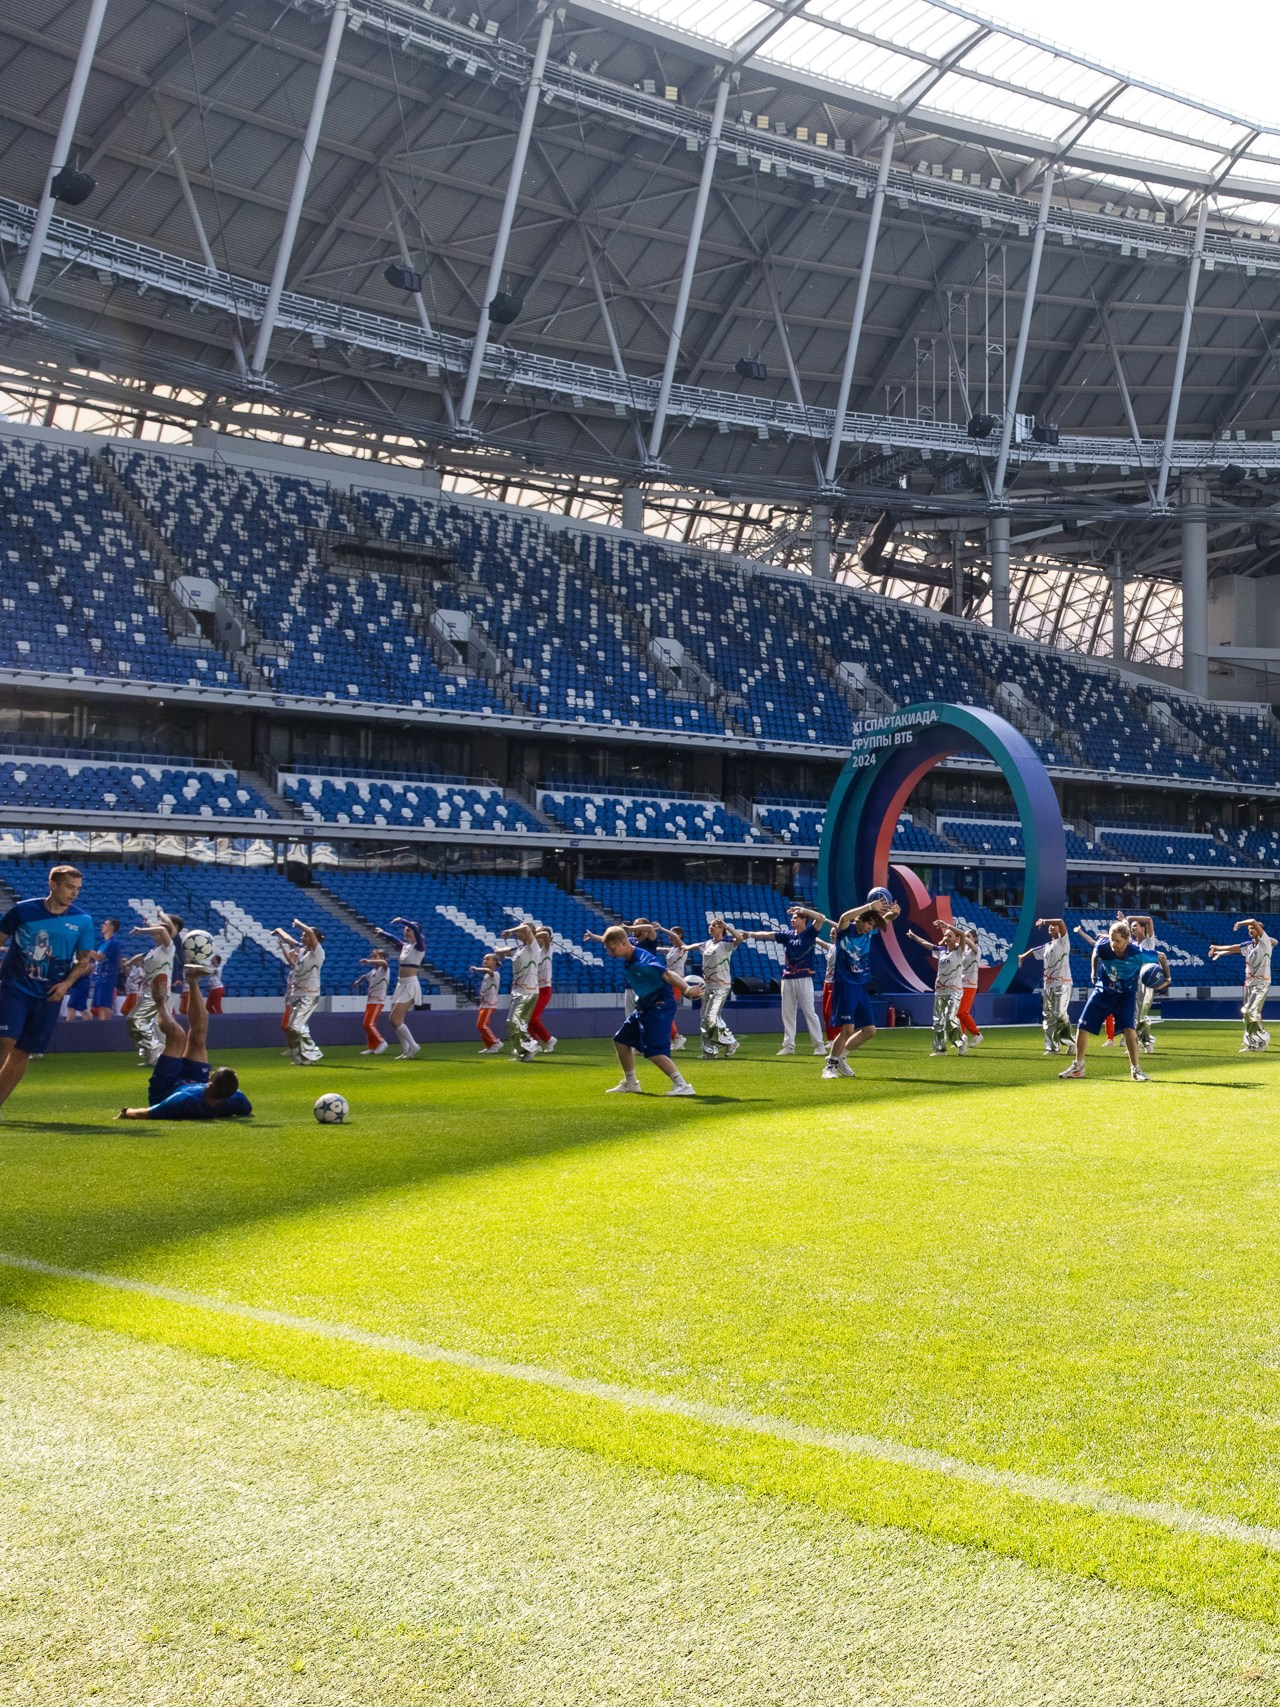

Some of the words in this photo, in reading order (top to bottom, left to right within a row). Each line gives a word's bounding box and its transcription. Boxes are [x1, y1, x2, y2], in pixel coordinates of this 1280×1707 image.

[864, 709, 939, 731] СПАРТАКИАДА
[852, 735, 892, 750] ГРУППЫ
[894, 731, 913, 745] ВТБ
[852, 753, 876, 768] 2024
